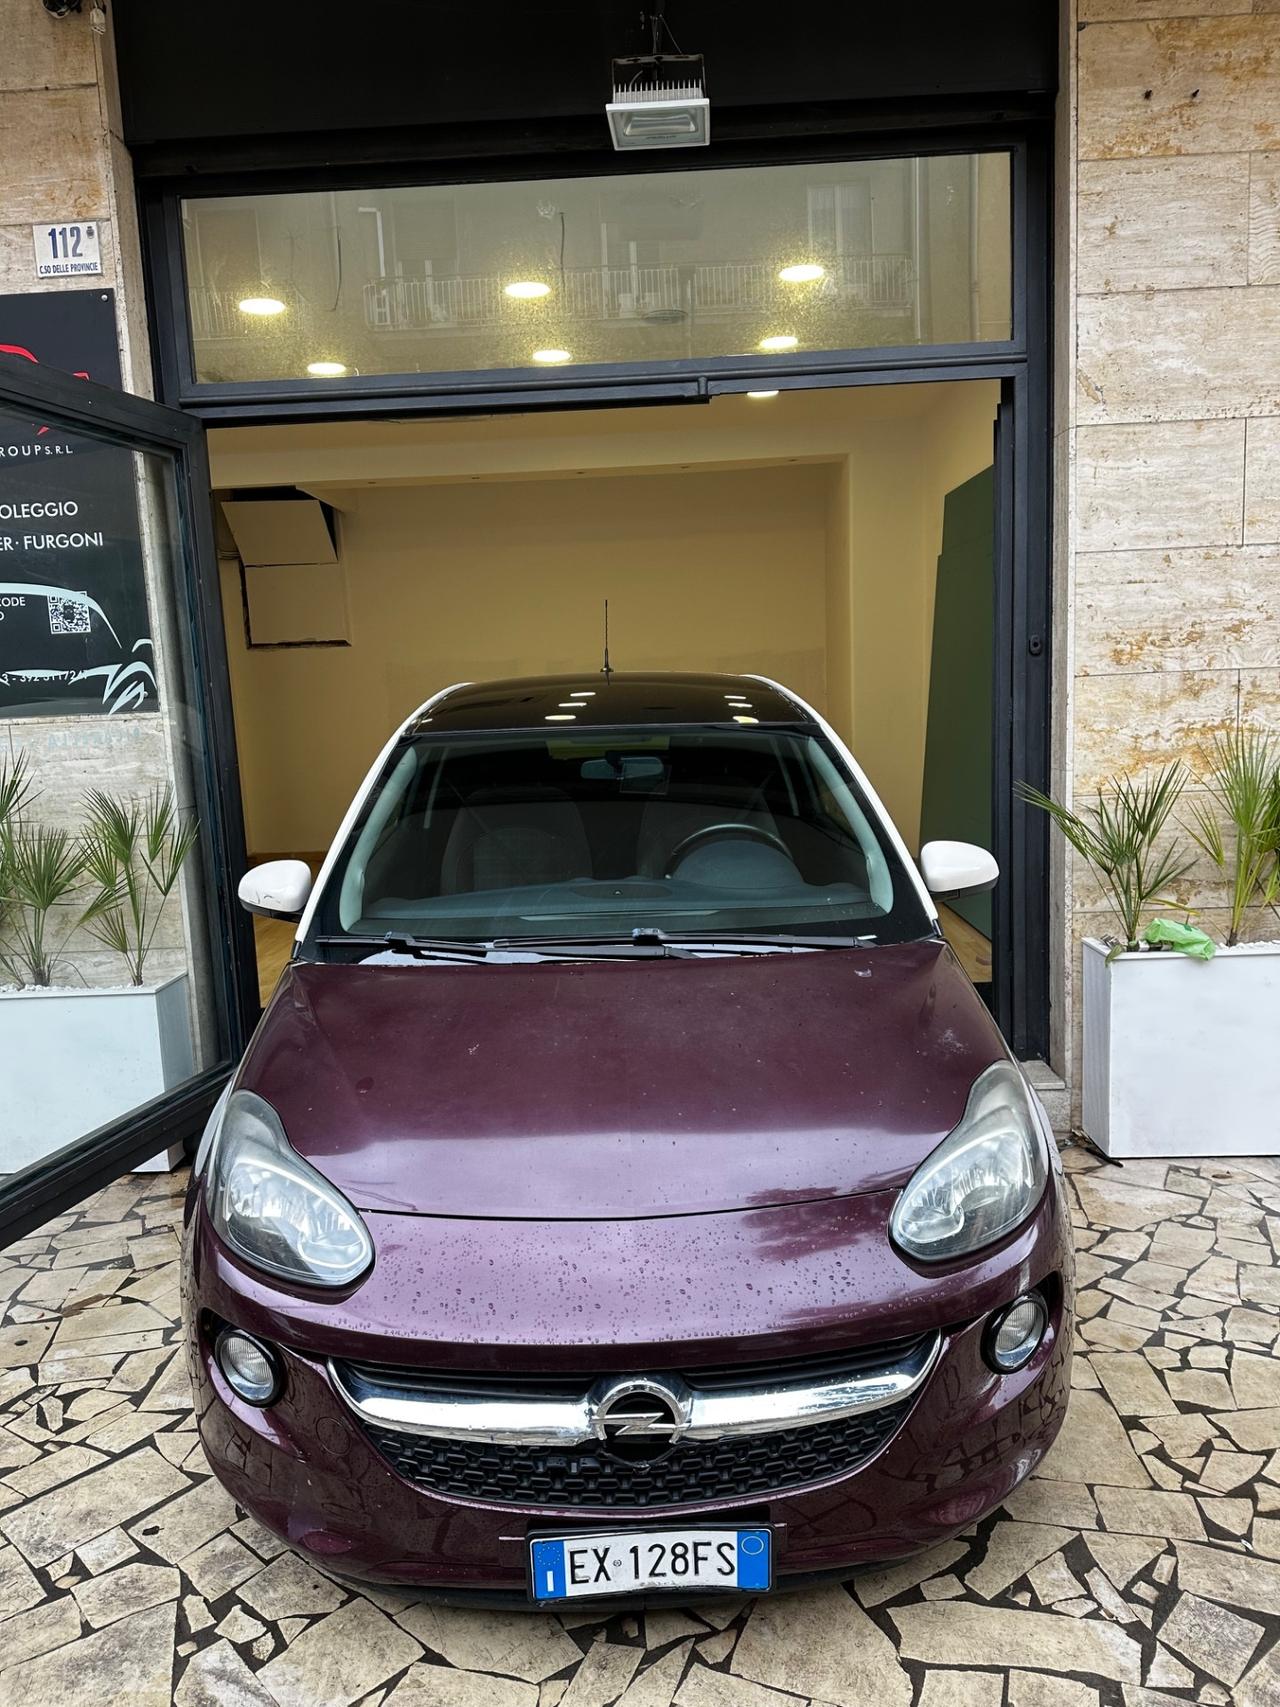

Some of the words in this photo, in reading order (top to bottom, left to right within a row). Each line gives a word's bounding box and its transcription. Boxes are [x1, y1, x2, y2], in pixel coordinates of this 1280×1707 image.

[48, 226, 83, 259] 112
[52, 263, 70, 274] DELLE
[70, 262, 99, 272] PROVINCIE
[0, 501, 78, 519] OLEGGIO
[23, 532, 104, 550] FURGONI
[0, 596, 26, 607] ODE
[569, 1547, 612, 1585] EX
[629, 1541, 736, 1580] 128FS
